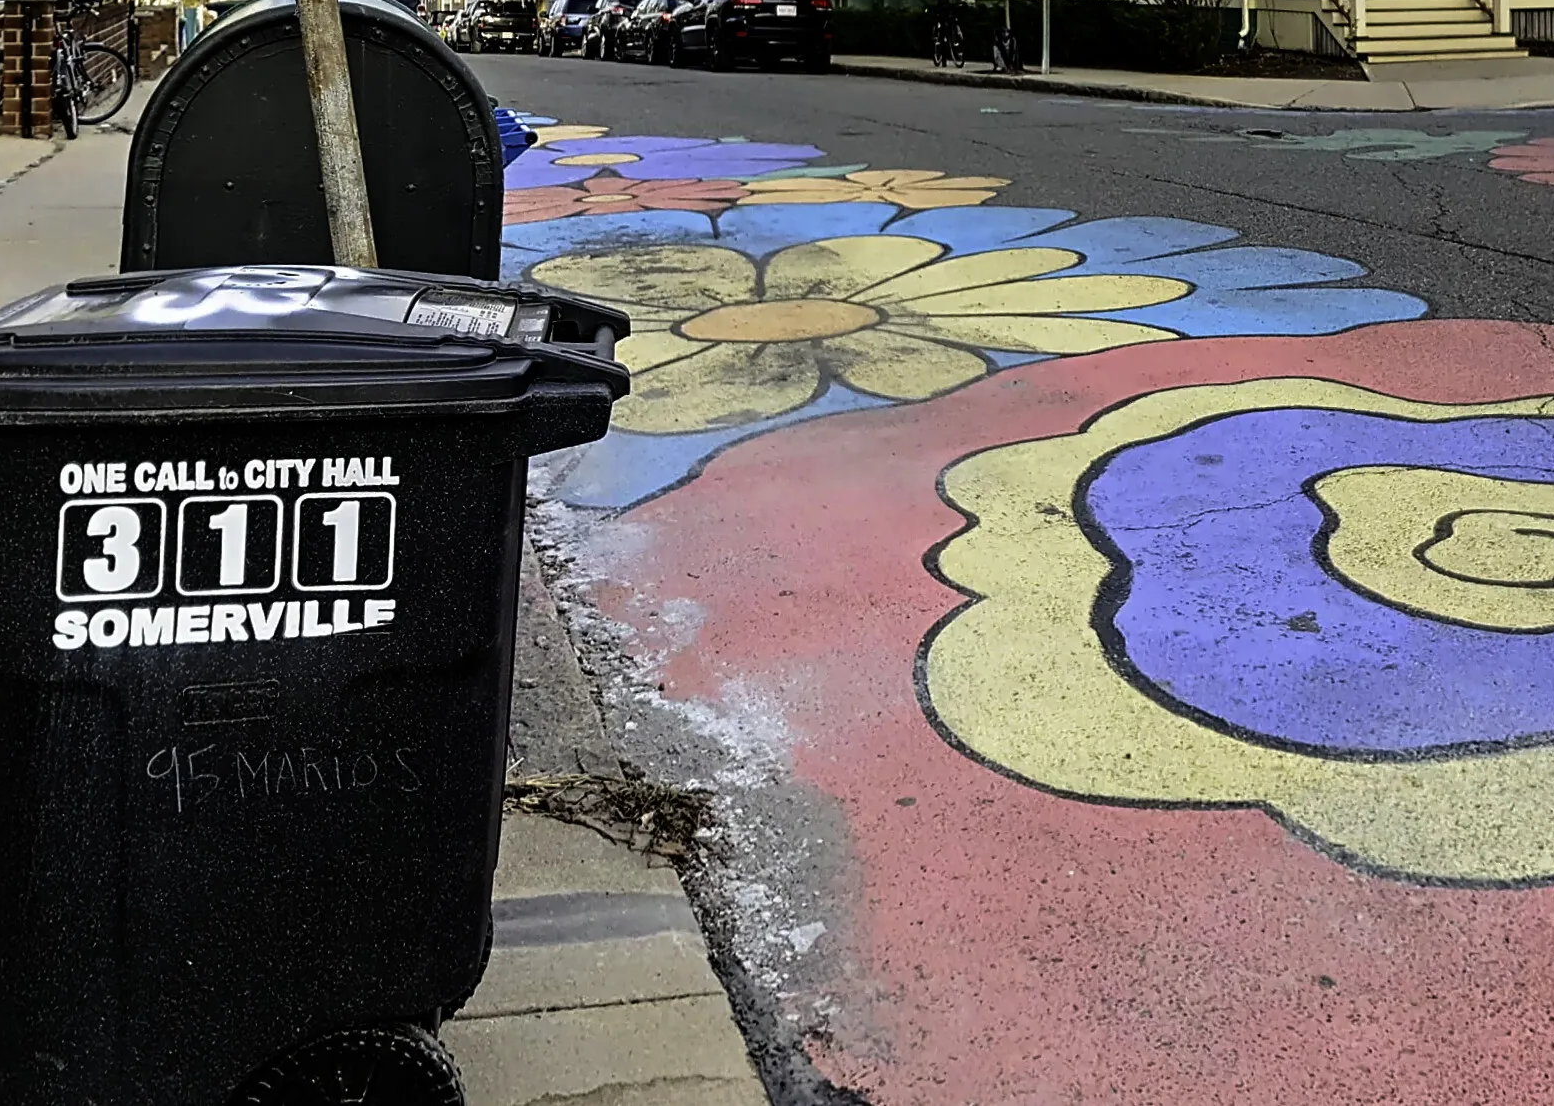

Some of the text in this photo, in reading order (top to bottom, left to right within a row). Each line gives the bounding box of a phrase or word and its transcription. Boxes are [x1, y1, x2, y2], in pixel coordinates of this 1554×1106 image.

[59, 456, 400, 495] ONE CALL to CITY HALL
[52, 598, 397, 650] SOMERVILLE
[146, 743, 221, 813] 95
